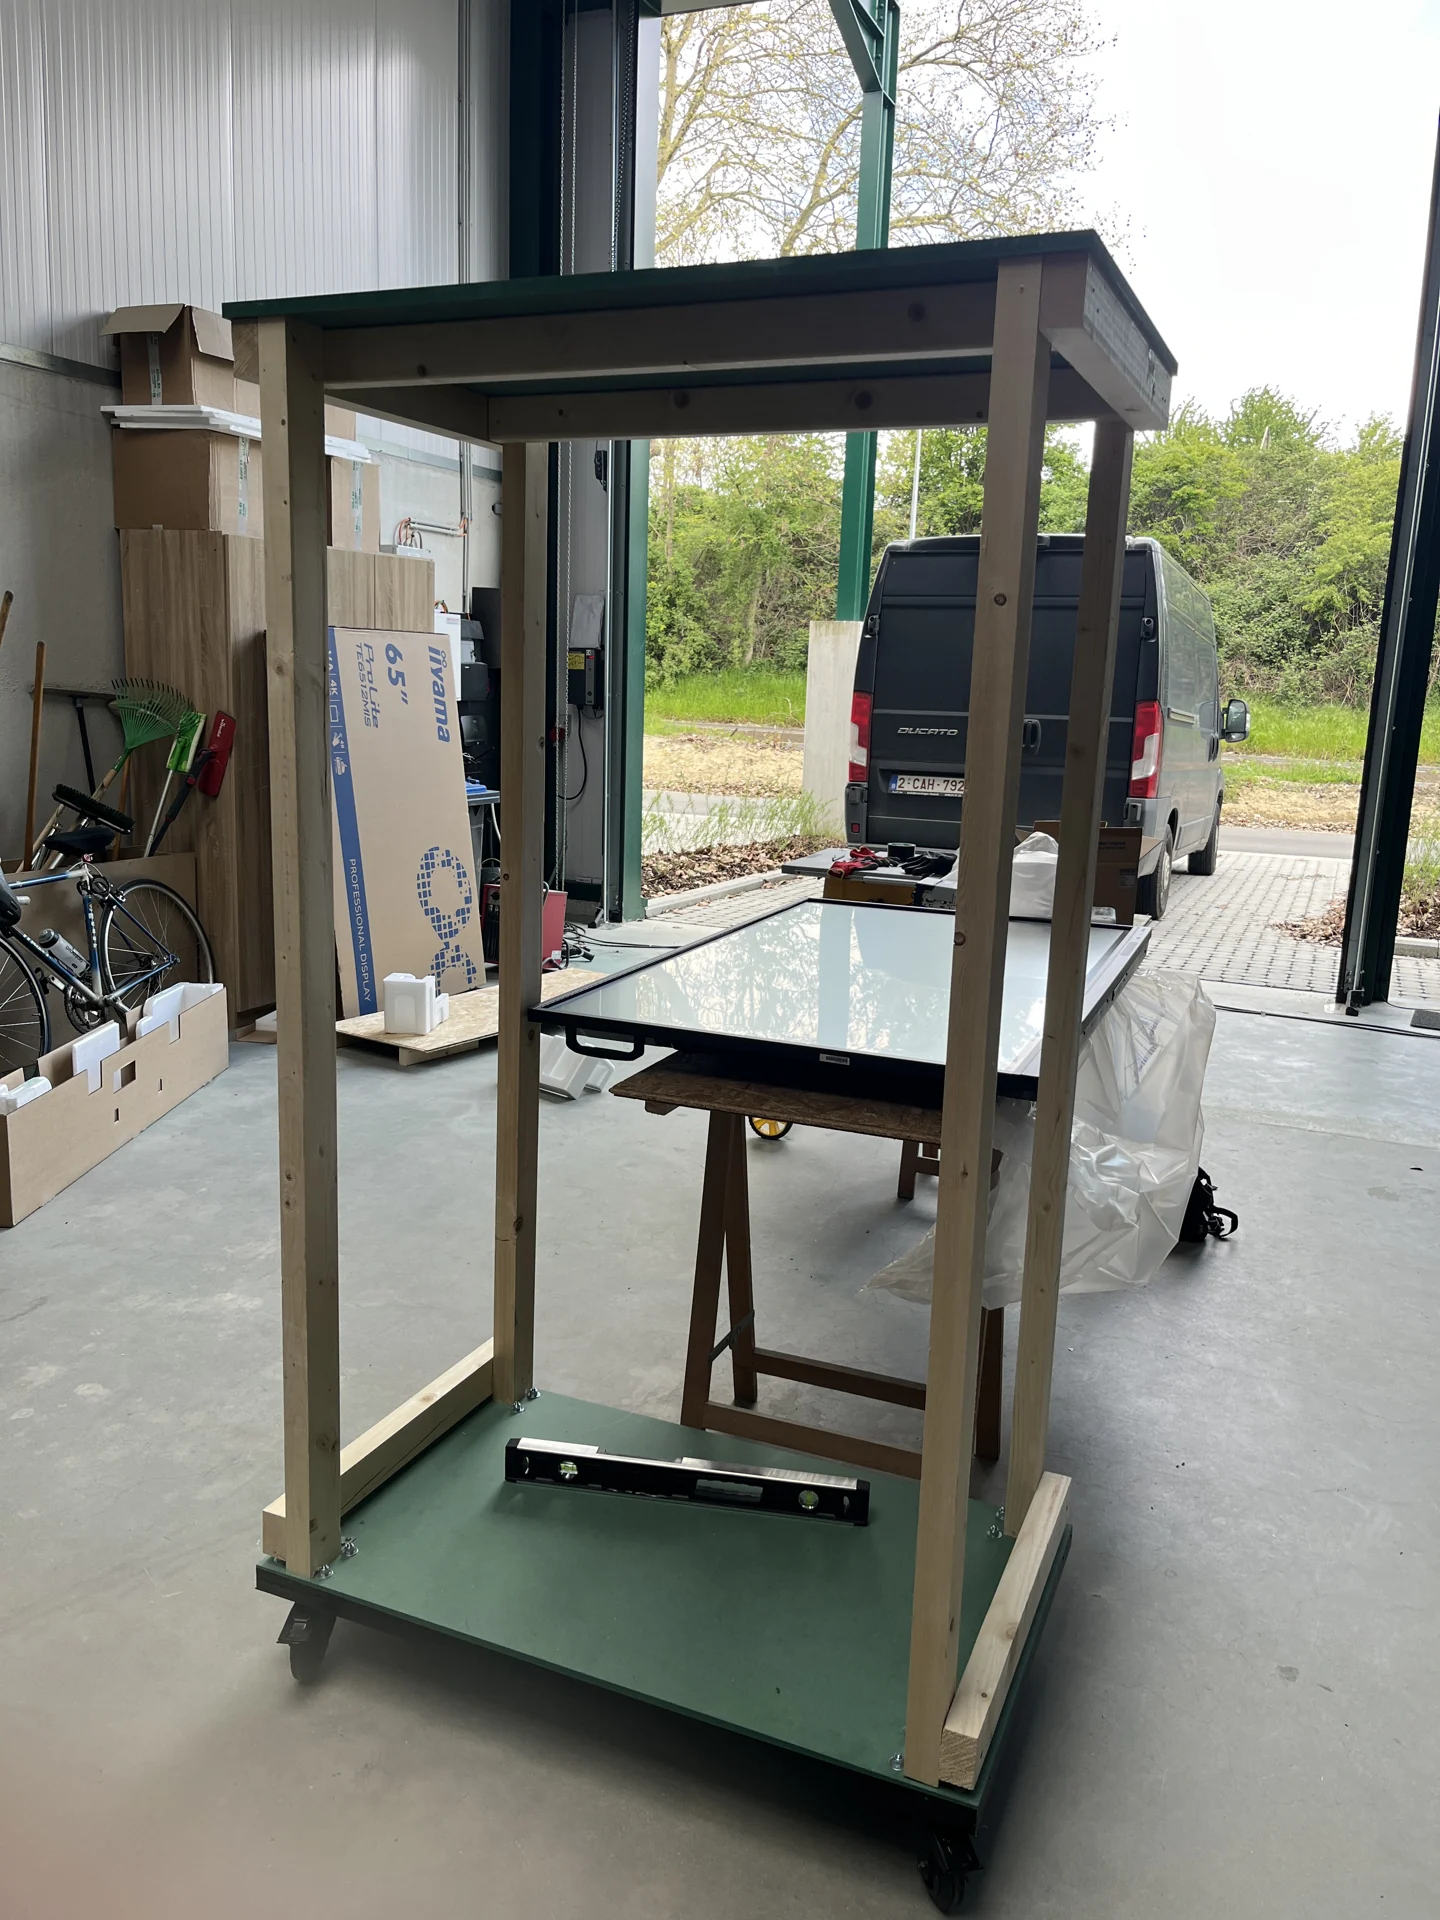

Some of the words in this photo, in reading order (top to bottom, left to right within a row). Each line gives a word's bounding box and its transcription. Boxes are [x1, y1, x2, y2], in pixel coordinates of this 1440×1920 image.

[331, 679, 338, 695] 4K
[356, 643, 371, 727] TE6512MIS
[364, 643, 380, 728] ProLite
[385, 643, 408, 705] 65"
[428, 645, 451, 743] iiyama
[897, 728, 958, 736] DUCATO
[350, 859, 366, 952] PROFESSIONAL
[360, 954, 372, 1002] DISPLAY
